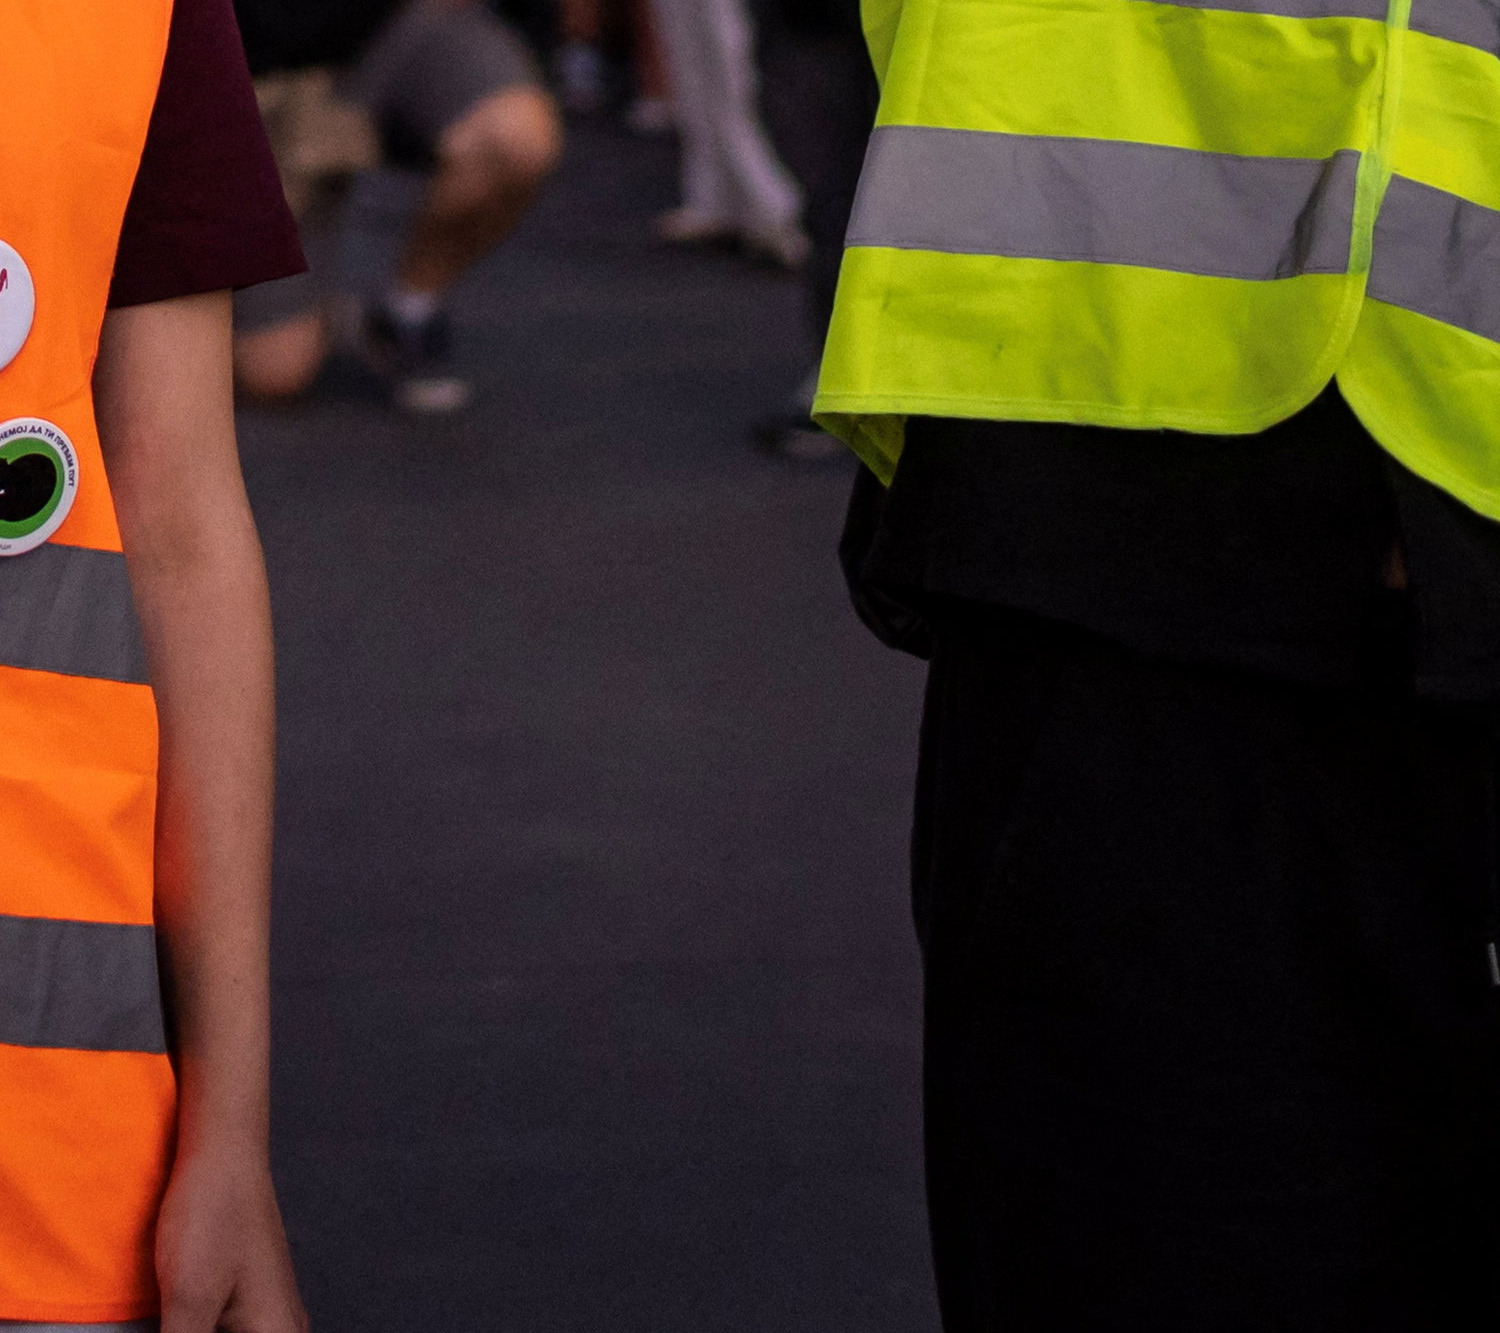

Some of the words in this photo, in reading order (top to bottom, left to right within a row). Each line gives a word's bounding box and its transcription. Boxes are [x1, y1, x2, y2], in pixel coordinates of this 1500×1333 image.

[28, 425, 43, 435] ДА
[44, 427, 56, 440] ТИ
[68, 469, 76, 488] ПУТ
